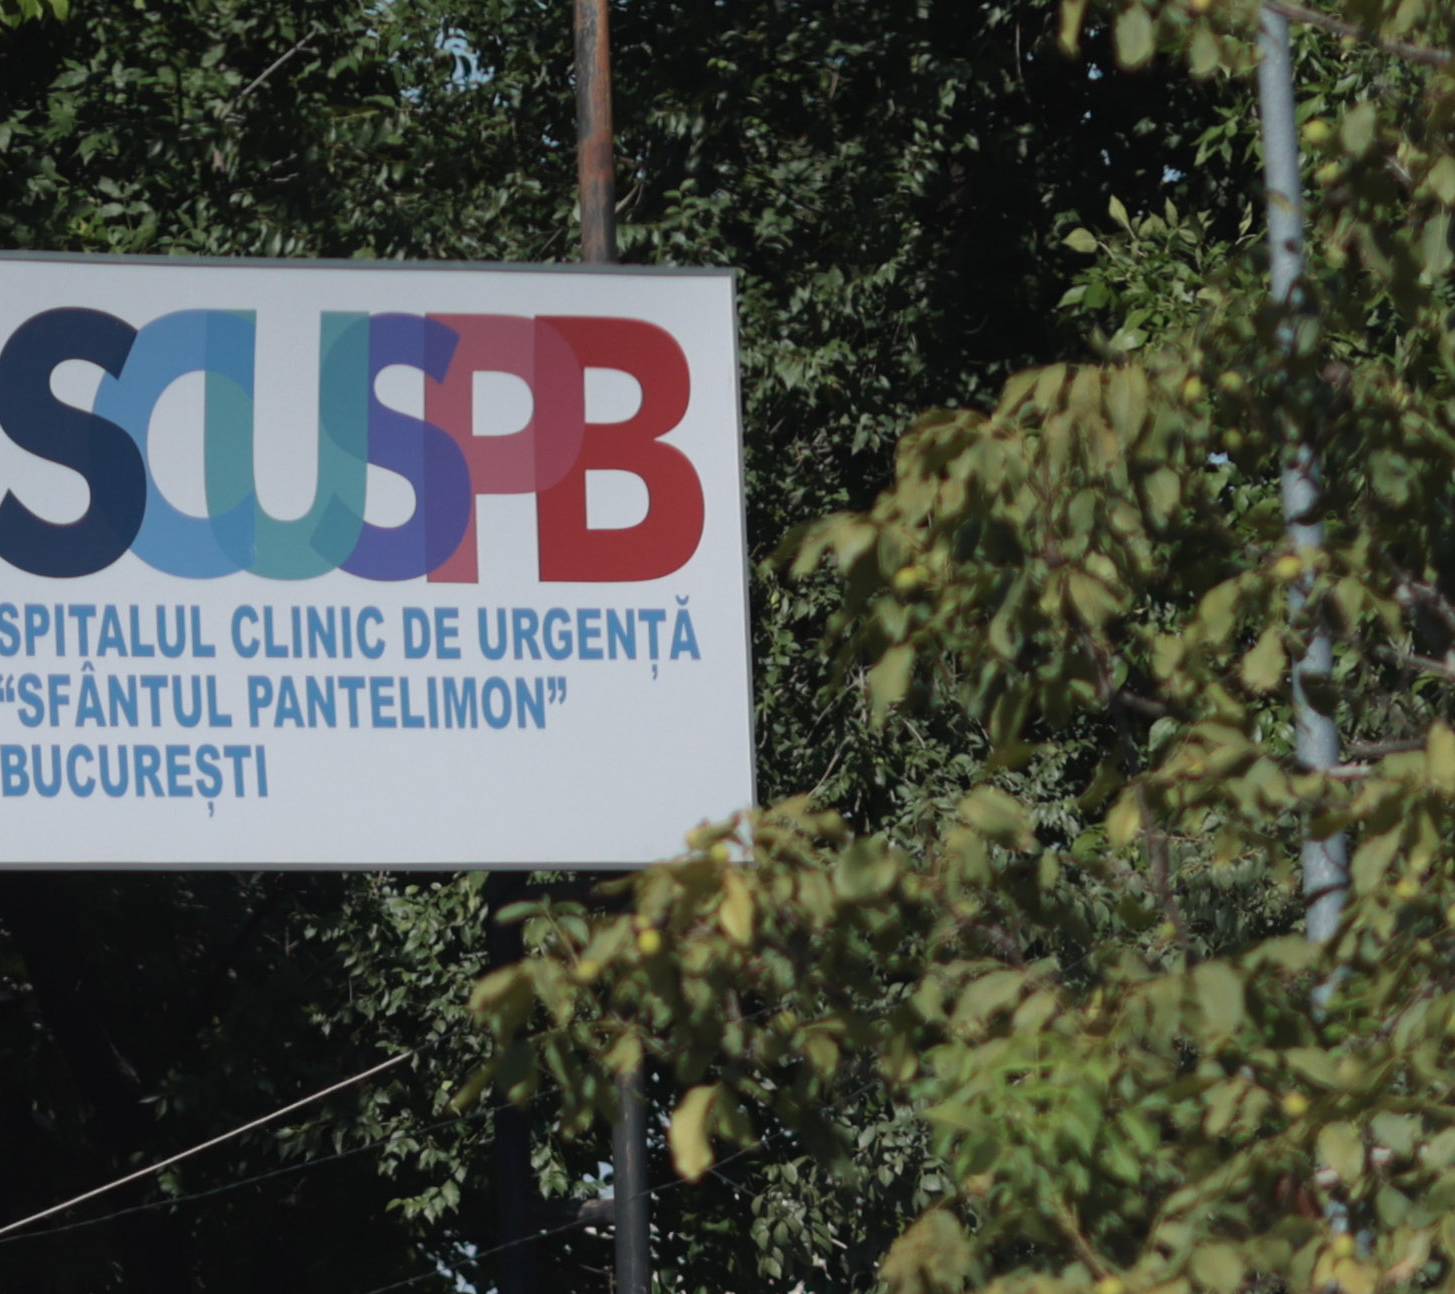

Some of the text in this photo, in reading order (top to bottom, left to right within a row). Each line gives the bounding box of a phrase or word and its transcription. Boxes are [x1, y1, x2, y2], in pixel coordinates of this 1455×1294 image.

[230, 604, 386, 662] CLINIC
[402, 606, 462, 662] DE
[476, 592, 701, 682] URGENȚĂ
